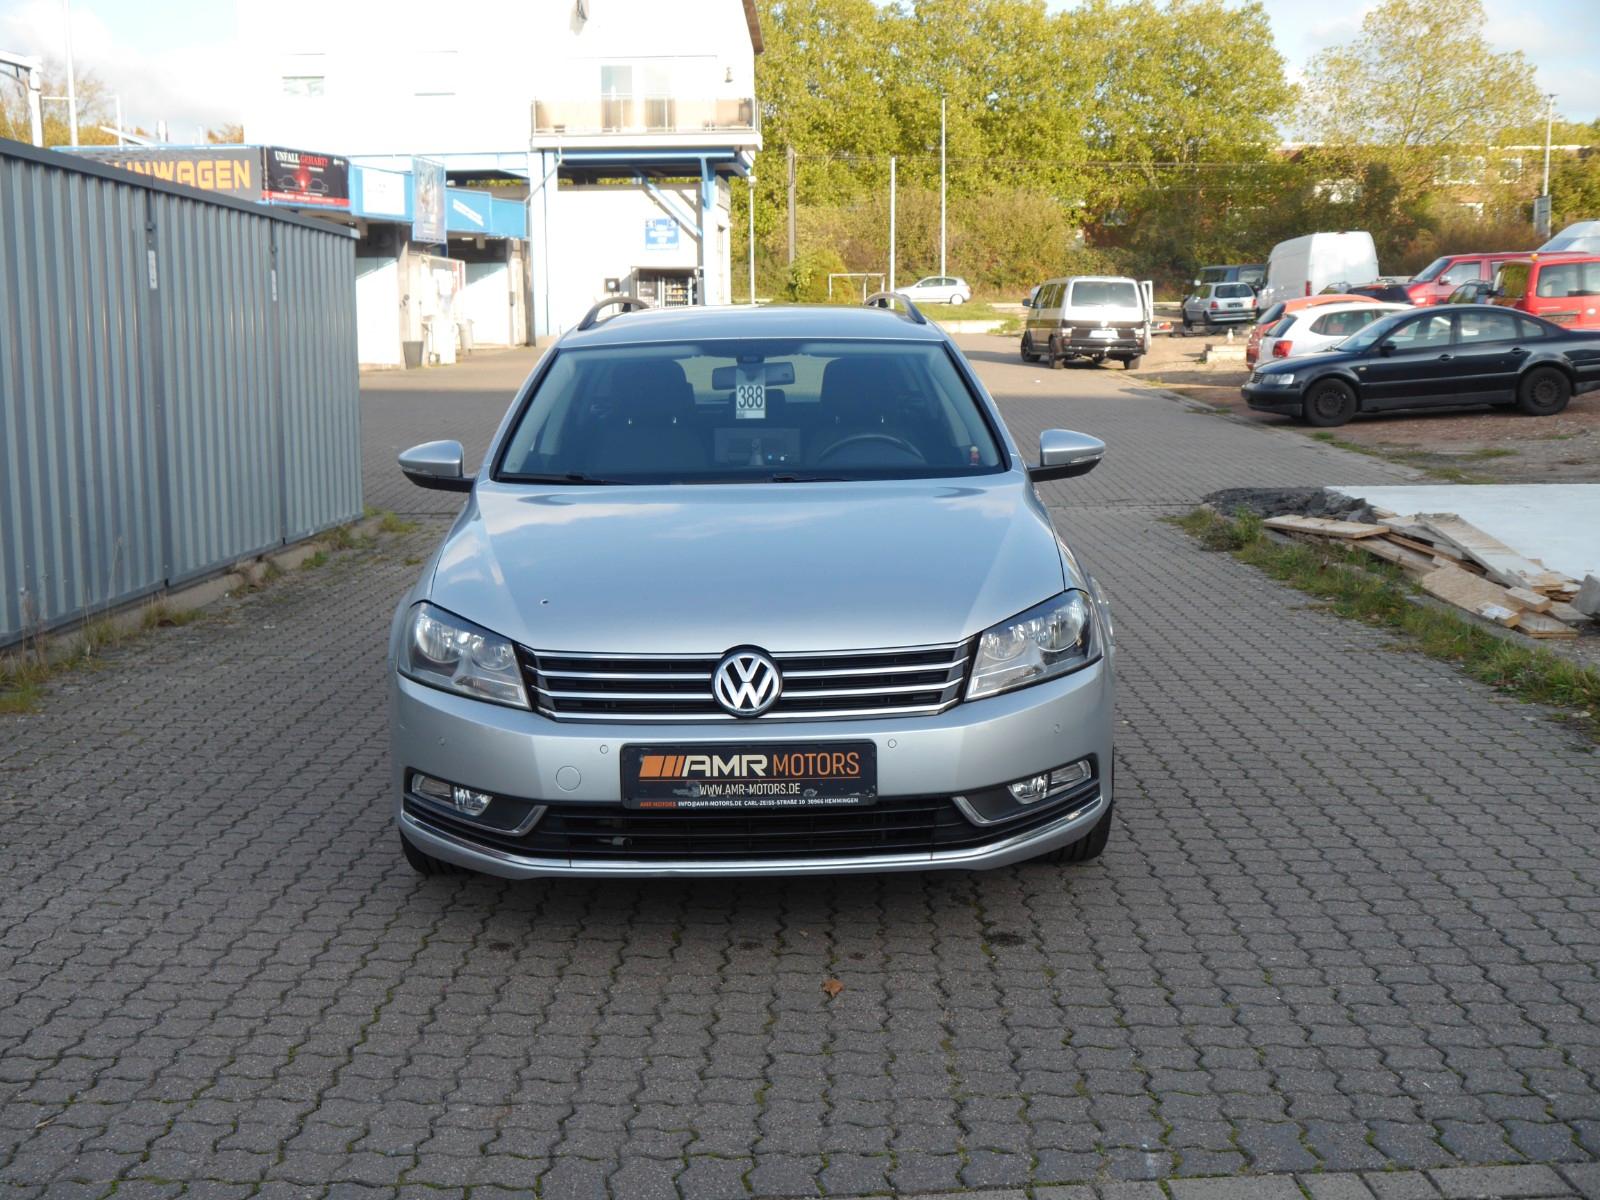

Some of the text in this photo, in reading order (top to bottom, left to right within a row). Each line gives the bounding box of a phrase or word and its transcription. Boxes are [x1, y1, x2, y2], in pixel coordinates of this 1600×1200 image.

[738, 385, 763, 409] 388
[716, 654, 778, 711] VW
[682, 752, 860, 777] AMR MOTORS
[699, 783, 801, 797] WWW.AMR-MOTORS.DE
